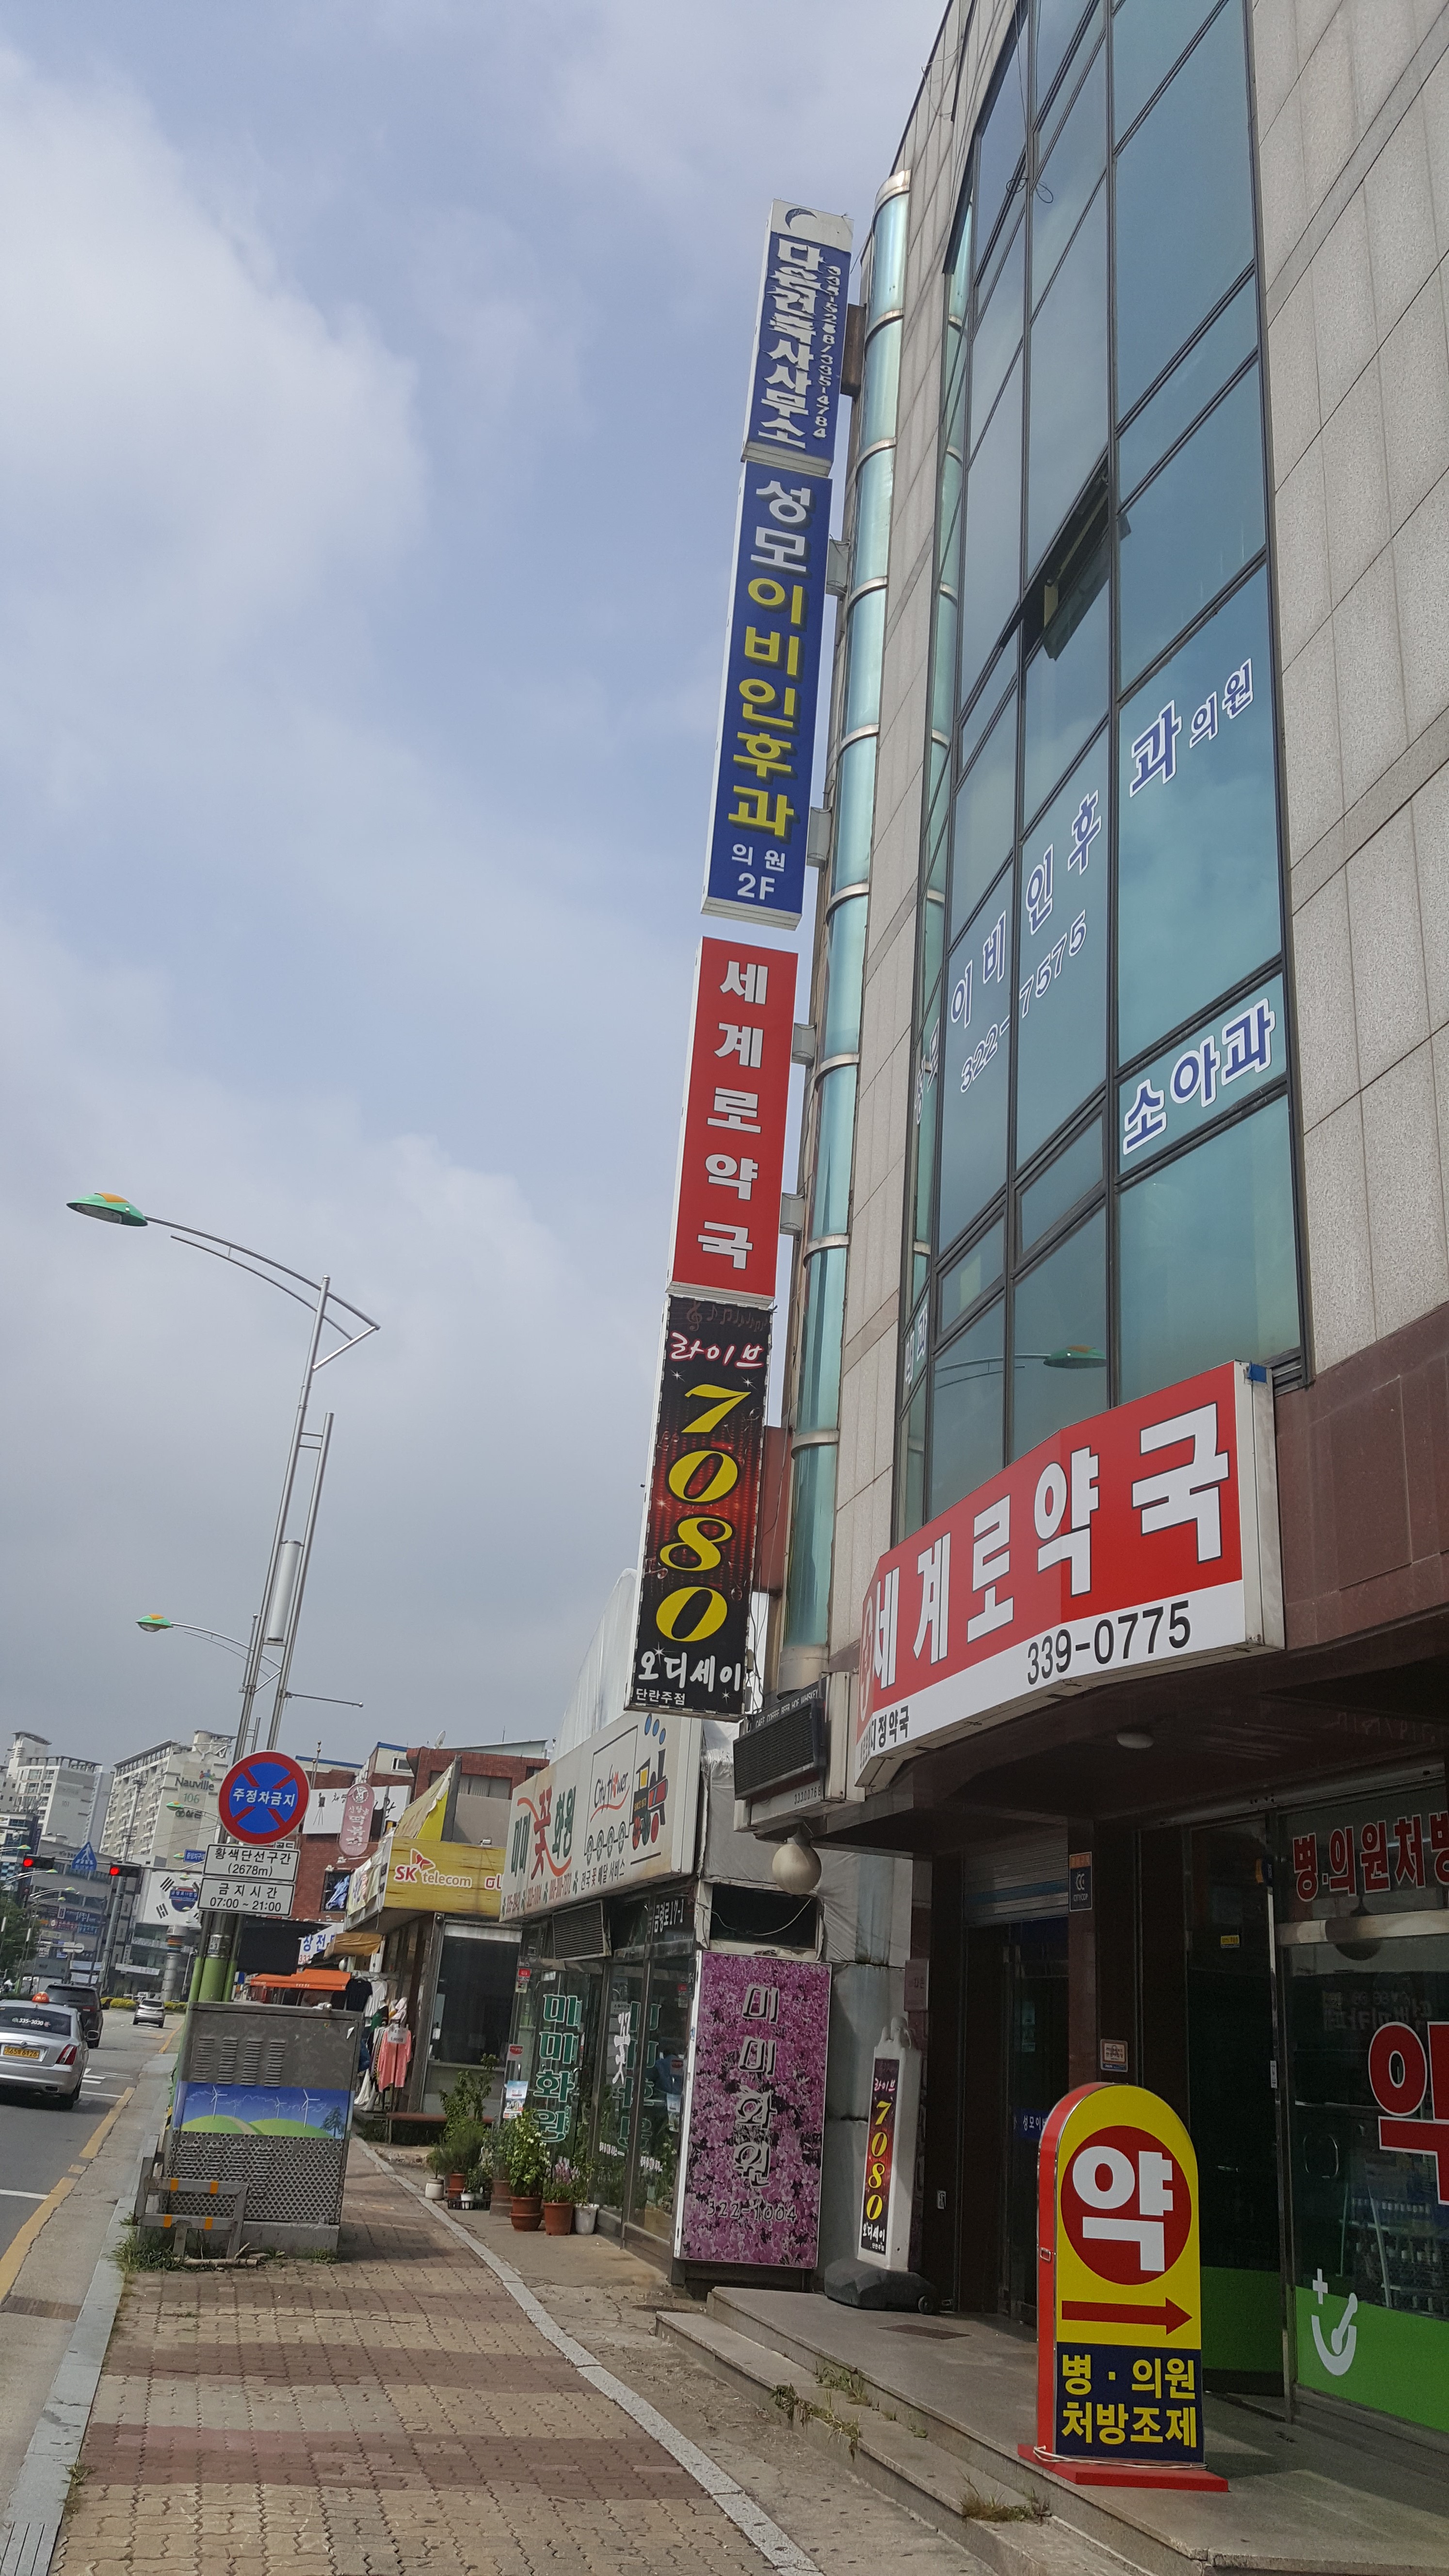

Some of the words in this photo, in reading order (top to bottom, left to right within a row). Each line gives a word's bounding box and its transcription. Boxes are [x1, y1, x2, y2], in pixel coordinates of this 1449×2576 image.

[737, 873, 775, 900] 2F
[1123, 998, 1275, 1155] 소아과
[697, 960, 769, 1270] 세계로약국
[668, 1331, 765, 1369] 라이브
[656, 1384, 752, 1642] 7080
[874, 1401, 1230, 1690] 세계로약국
[1027, 1599, 1191, 1686] 339-0775
[637, 1651, 741, 1693] 오디세이
[636, 1688, 686, 1707] 단란주점
[781, 1703, 790, 1715] BEER
[175, 1776, 214, 1791] Nauville
[184, 1793, 200, 1803] 106
[232, 1788, 295, 1807] 주정차금지
[531, 1785, 553, 1880] 꽃
[215, 1847, 291, 1866] 황색단선구간
[228, 1863, 273, 1877] (2678m)
[395, 1866, 417, 1882] SK
[423, 1873, 472, 1888] telecom
[609, 1858, 625, 1882] 서비스
[219, 1883, 277, 1899] 금지시간
[209, 1897, 239, 1909] 07:00
[252, 1900, 281, 1912] 21:00
[18, 2017, 44, 2026] 335-3030
[732, 1983, 780, 2188] 미미화원
[873, 2077, 896, 2092] 라이브
[866, 2100, 891, 2221] 7080
[707, 2199, 796, 2223] 322-1004
[1072, 2145, 1174, 2271] 약
[862, 2222, 886, 2242] 오디세이
[1062, 2402, 1197, 2449] 처방조제
